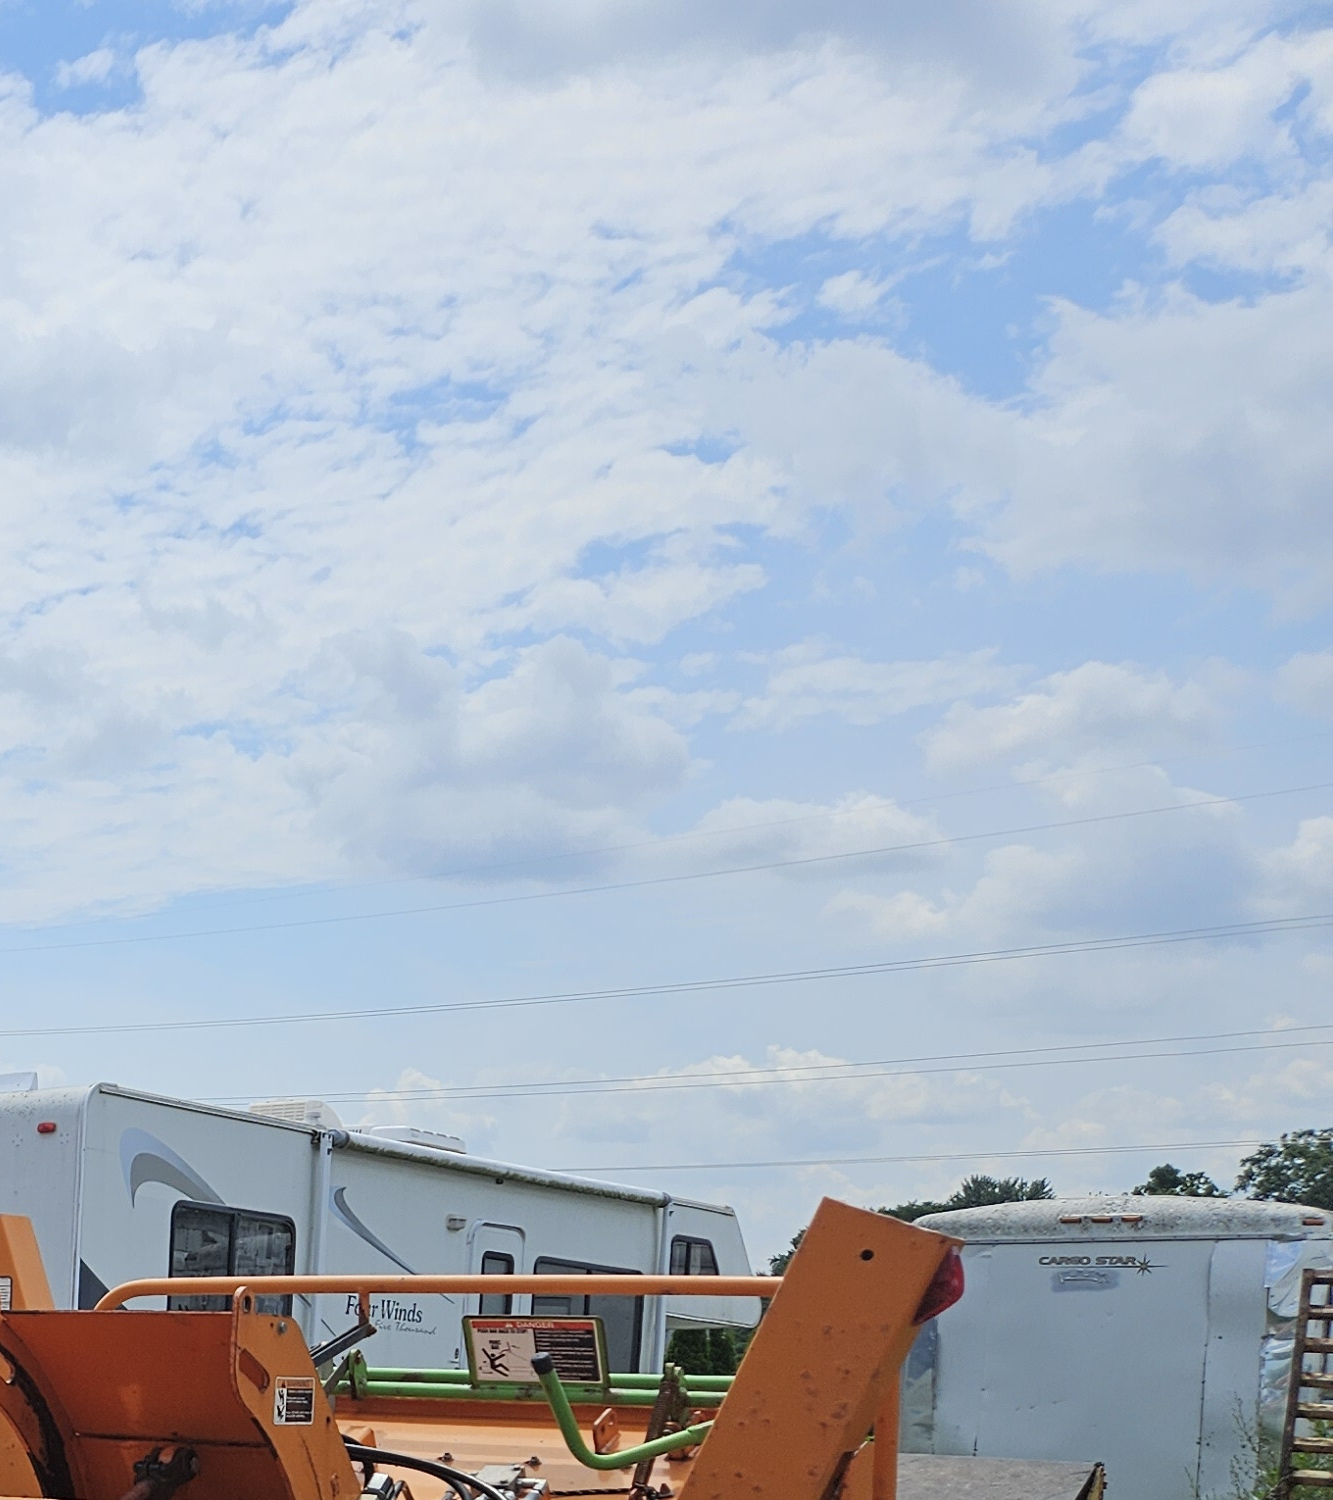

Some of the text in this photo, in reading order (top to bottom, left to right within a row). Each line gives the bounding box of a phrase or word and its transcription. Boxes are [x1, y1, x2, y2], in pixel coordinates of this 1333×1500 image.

[1038, 1256, 1137, 1265] CARGO STAR
[381, 1299, 423, 1324] Winds
